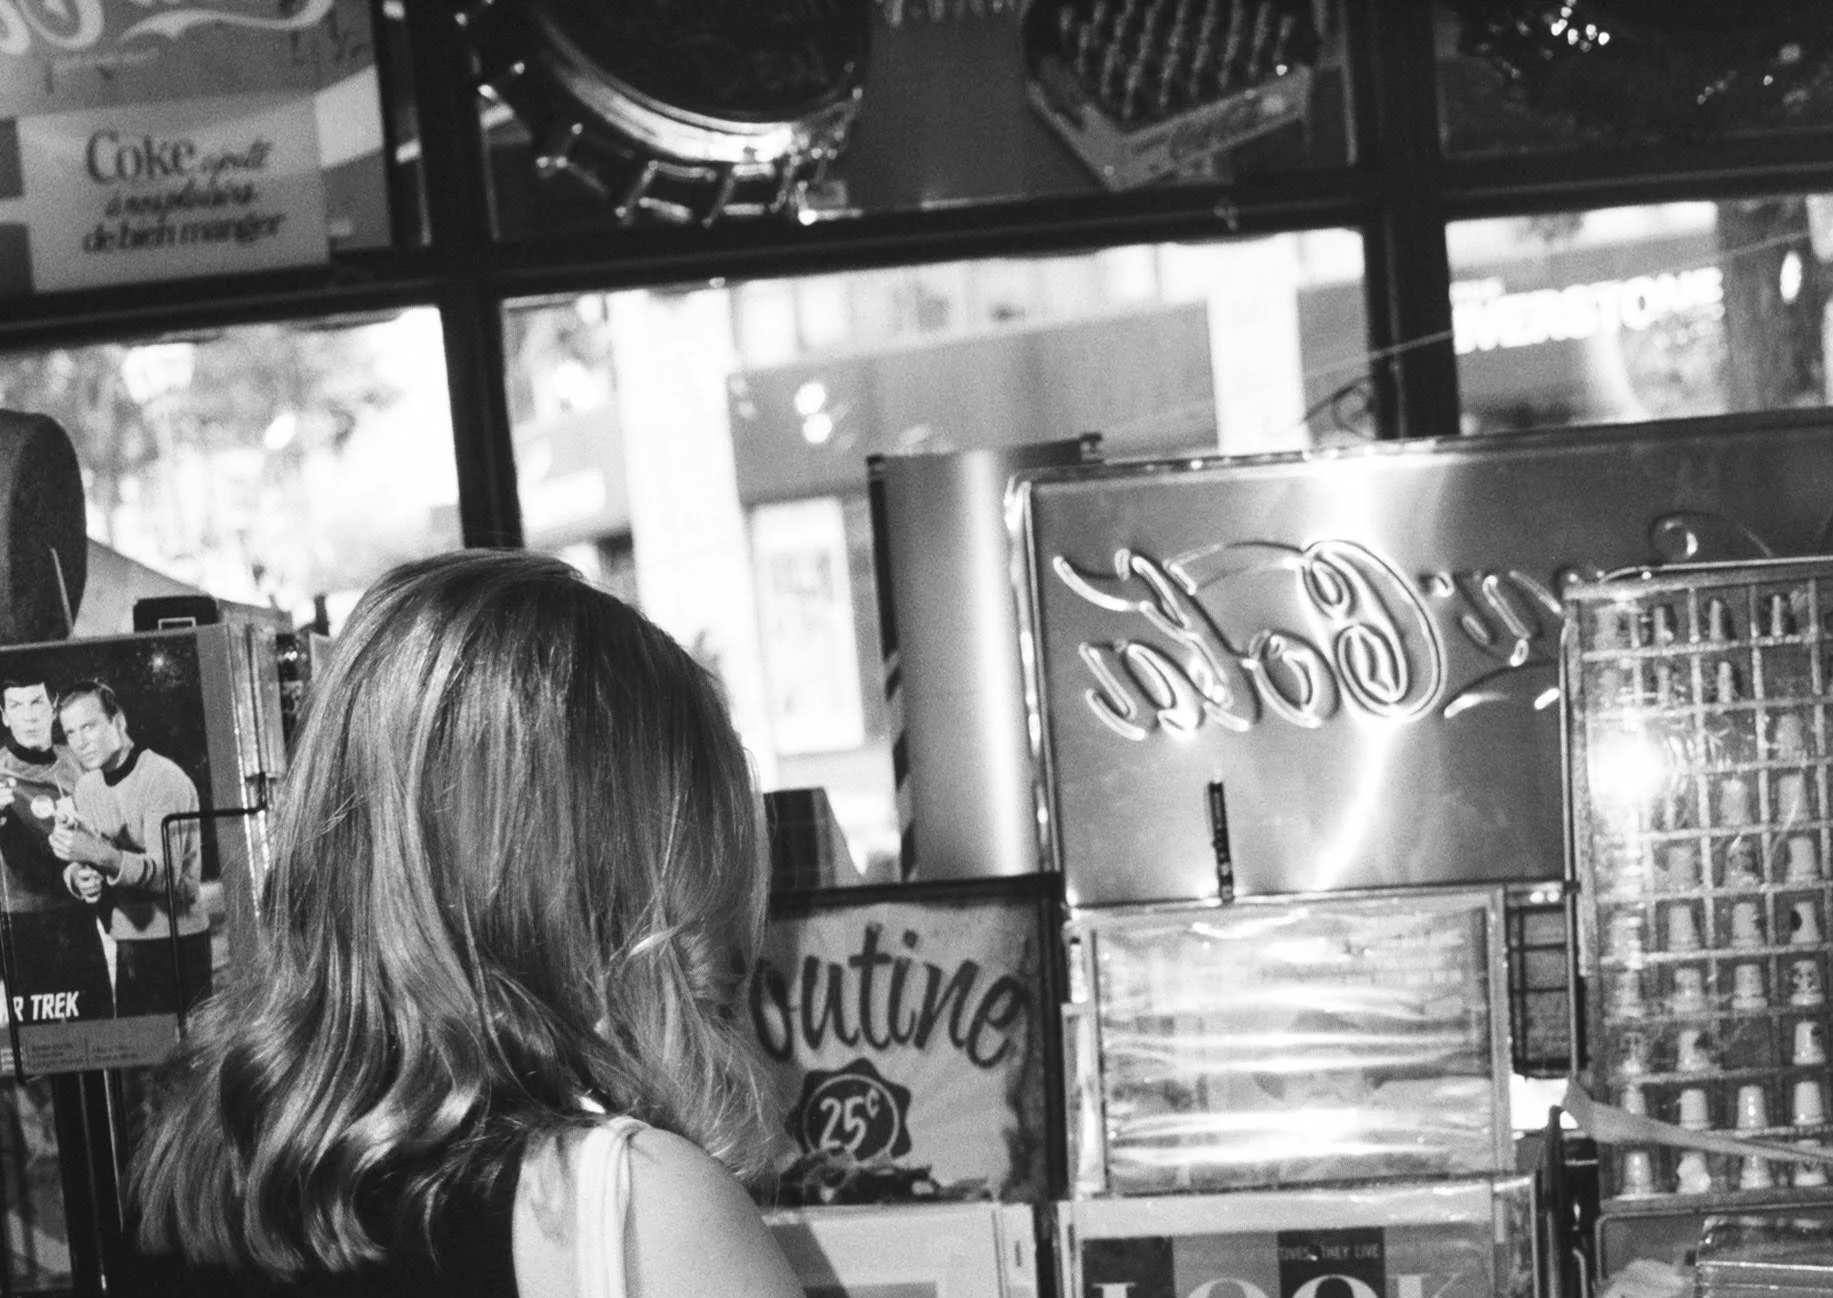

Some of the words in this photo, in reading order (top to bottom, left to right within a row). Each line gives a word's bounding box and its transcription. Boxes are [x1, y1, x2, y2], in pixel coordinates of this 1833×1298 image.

[86, 129, 196, 185] Coke
[30, 990, 81, 1021] TREK
[749, 921, 1027, 1069] outine
